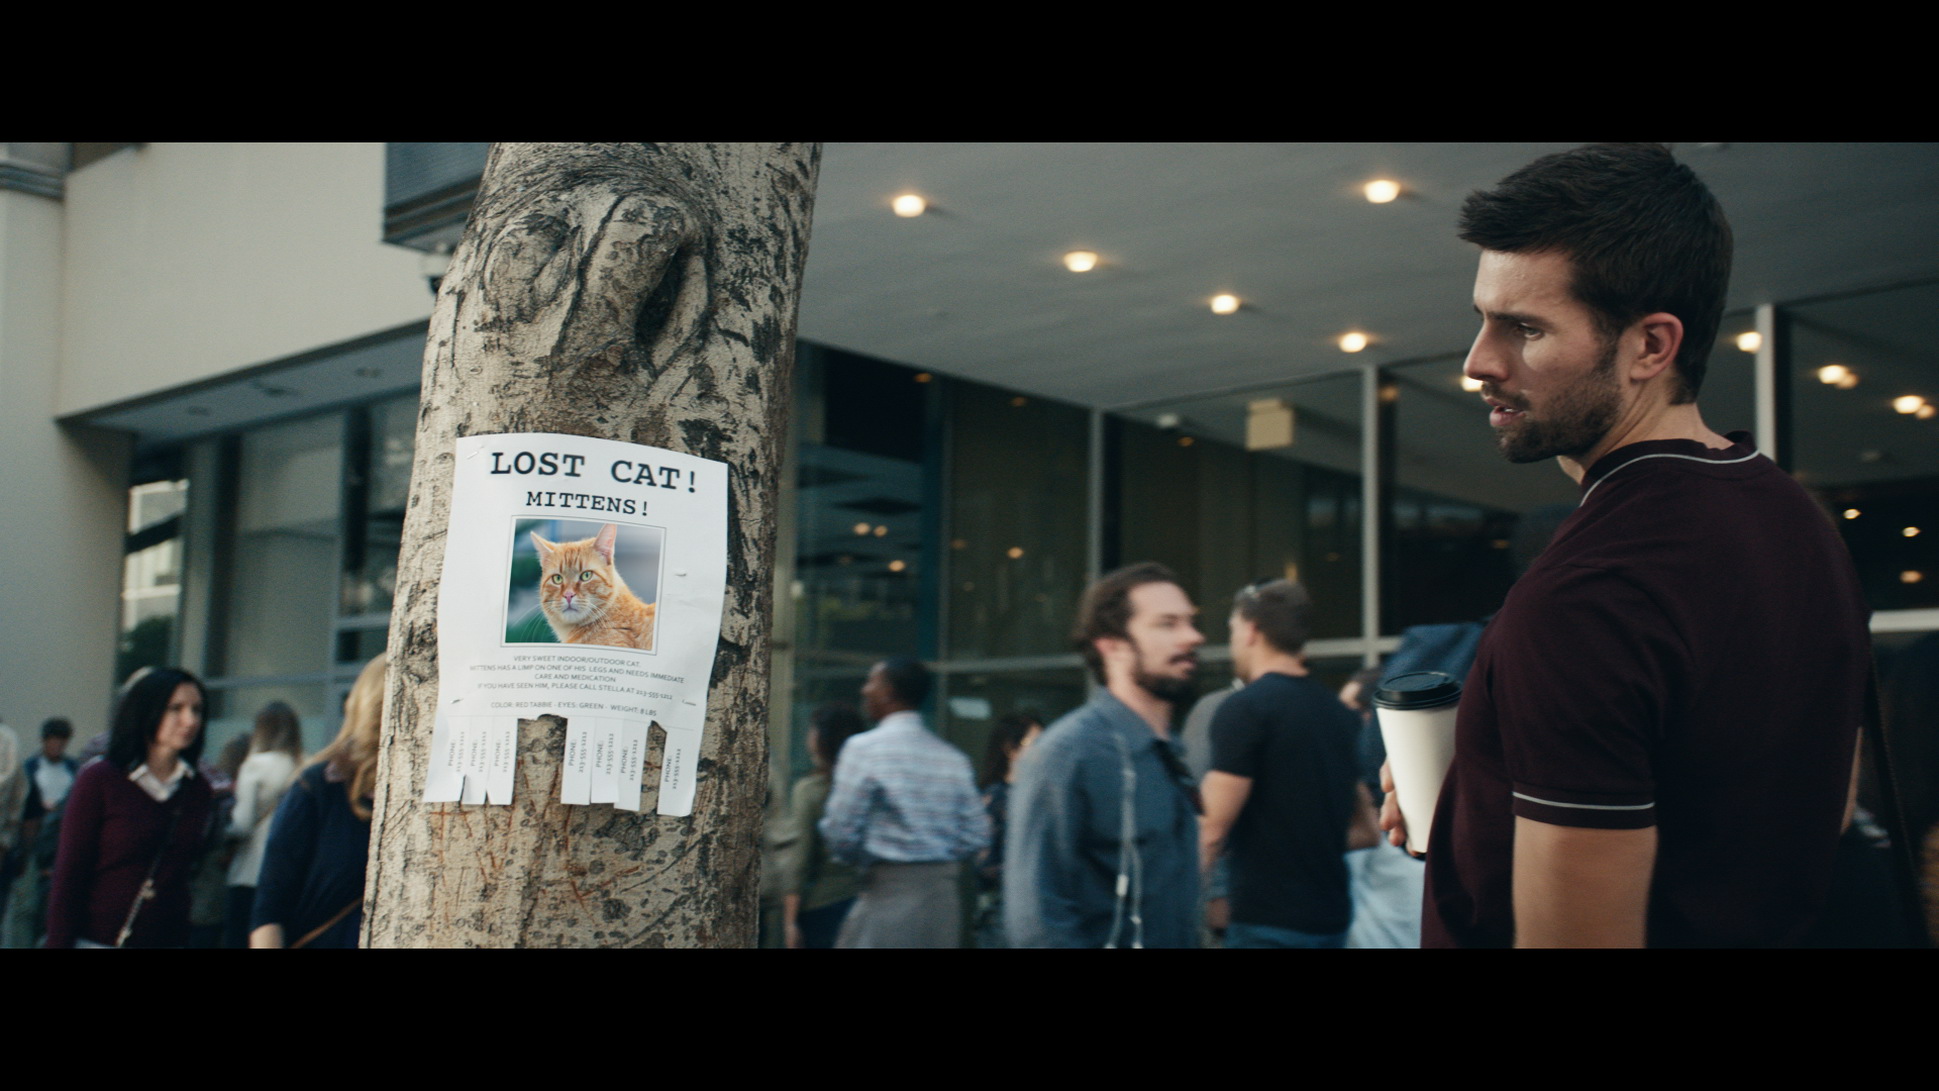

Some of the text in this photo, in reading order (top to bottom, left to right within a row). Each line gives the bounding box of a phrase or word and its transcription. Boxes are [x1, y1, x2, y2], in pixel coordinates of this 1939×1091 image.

[490, 451, 696, 493] LOST CAT!
[526, 491, 648, 516] MITTENS!
[557, 656, 625, 666] INDOOR/OUTDOOR
[570, 674, 616, 682] MEDICATION
[588, 666, 608, 674] LEGS
[626, 670, 649, 678] NEEDS
[650, 672, 686, 684] IMMEDIATE
[598, 684, 624, 693] STELLA
[645, 708, 657, 716] LBS
